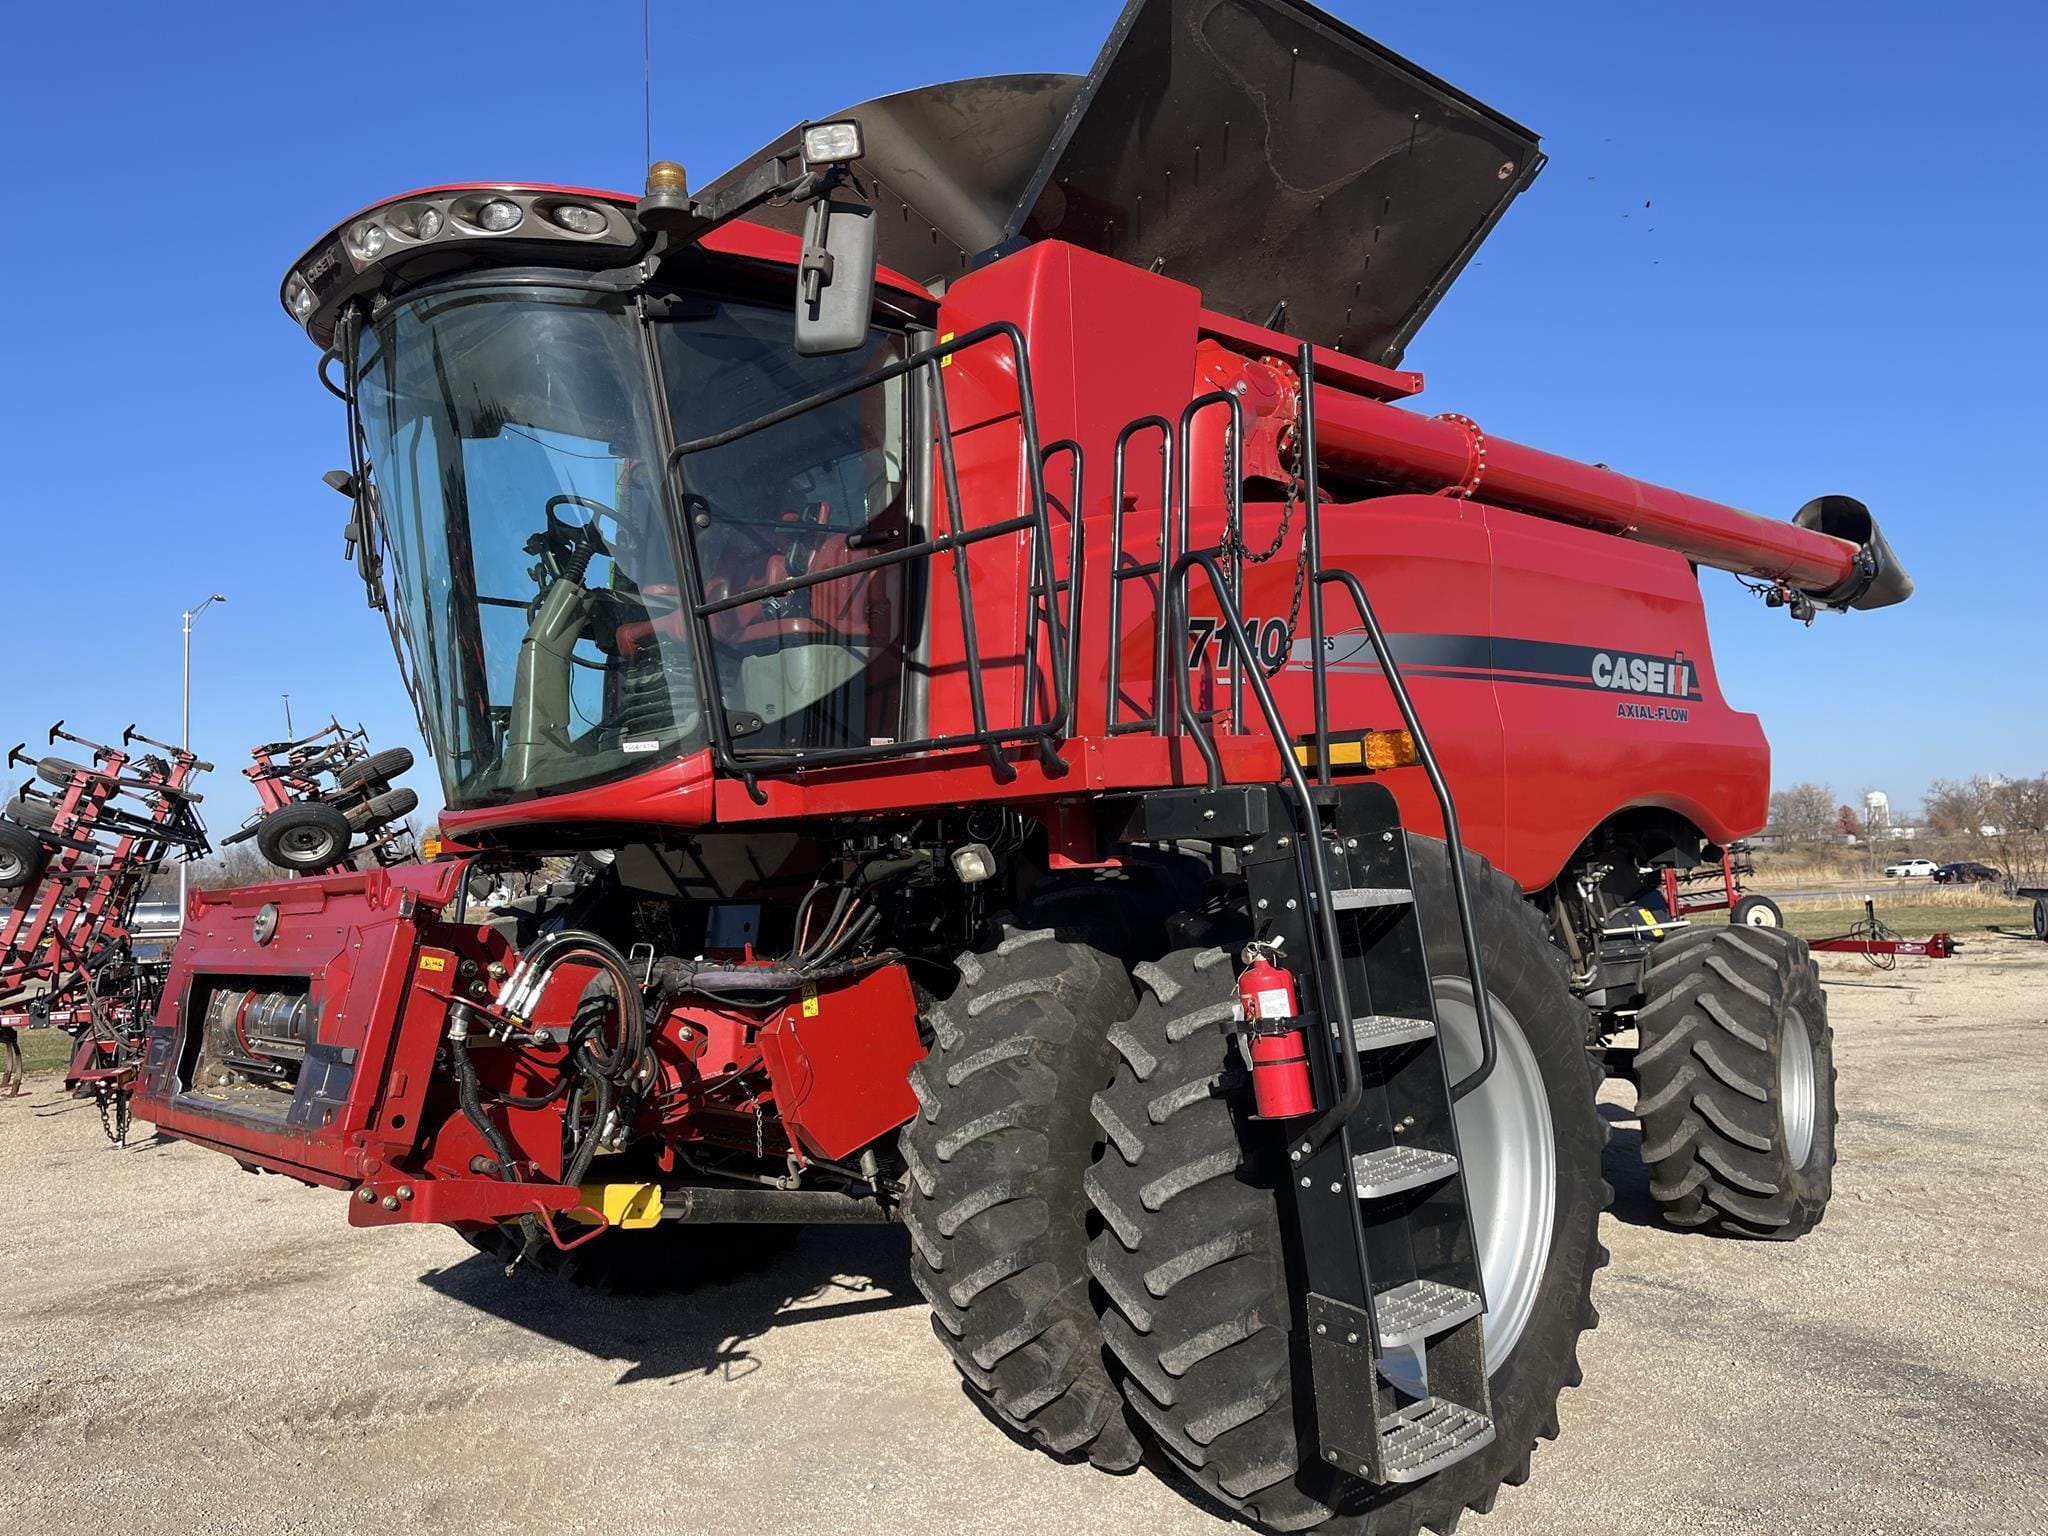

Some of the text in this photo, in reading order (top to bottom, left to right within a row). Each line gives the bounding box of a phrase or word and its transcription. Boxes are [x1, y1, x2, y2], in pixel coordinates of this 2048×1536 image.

[307, 256, 328, 284] CASE
[1592, 653, 1665, 694] CASE
[1617, 703, 1688, 723] AXIAL-FLOW
